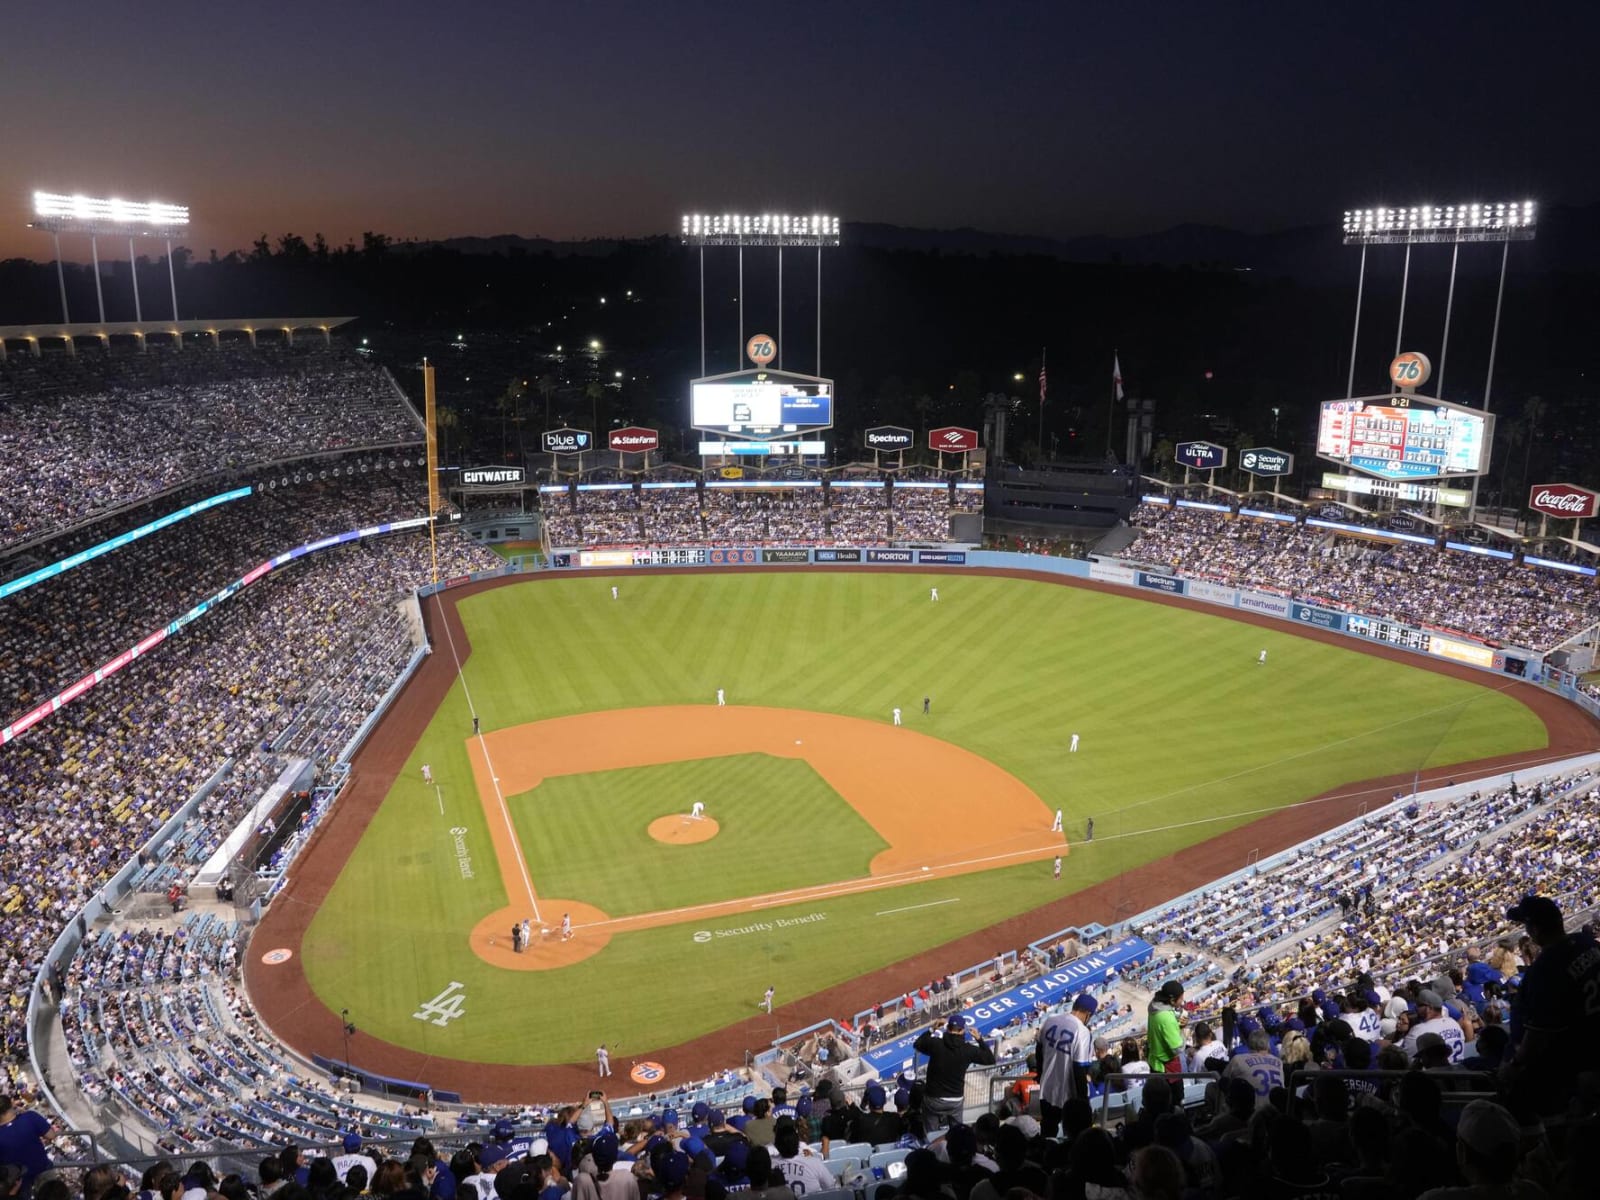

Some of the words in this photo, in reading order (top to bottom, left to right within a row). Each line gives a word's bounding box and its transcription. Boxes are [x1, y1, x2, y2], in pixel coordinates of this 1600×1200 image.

[752, 341, 773, 357] 76
[1397, 360, 1419, 379] 76
[1391, 398, 1409, 406] 8:21
[547, 434, 575, 445] blue
[869, 433, 908, 444] Spectrum
[1186, 449, 1213, 459] ULTRA
[1258, 453, 1286, 465] Security
[1258, 462, 1281, 472] Benefit
[464, 470, 520, 483] CUTWATER
[1146, 574, 1176, 586] Spectrum
[1242, 598, 1287, 613] smartwater
[714, 921, 774, 938] Security
[775, 911, 828, 928] Benefit
[1020, 956, 1107, 998] STADIUM
[412, 981, 466, 1026] LA
[1363, 1013, 1380, 1032] 42
[1045, 1025, 1074, 1055] 42
[1252, 1069, 1283, 1096] 35
